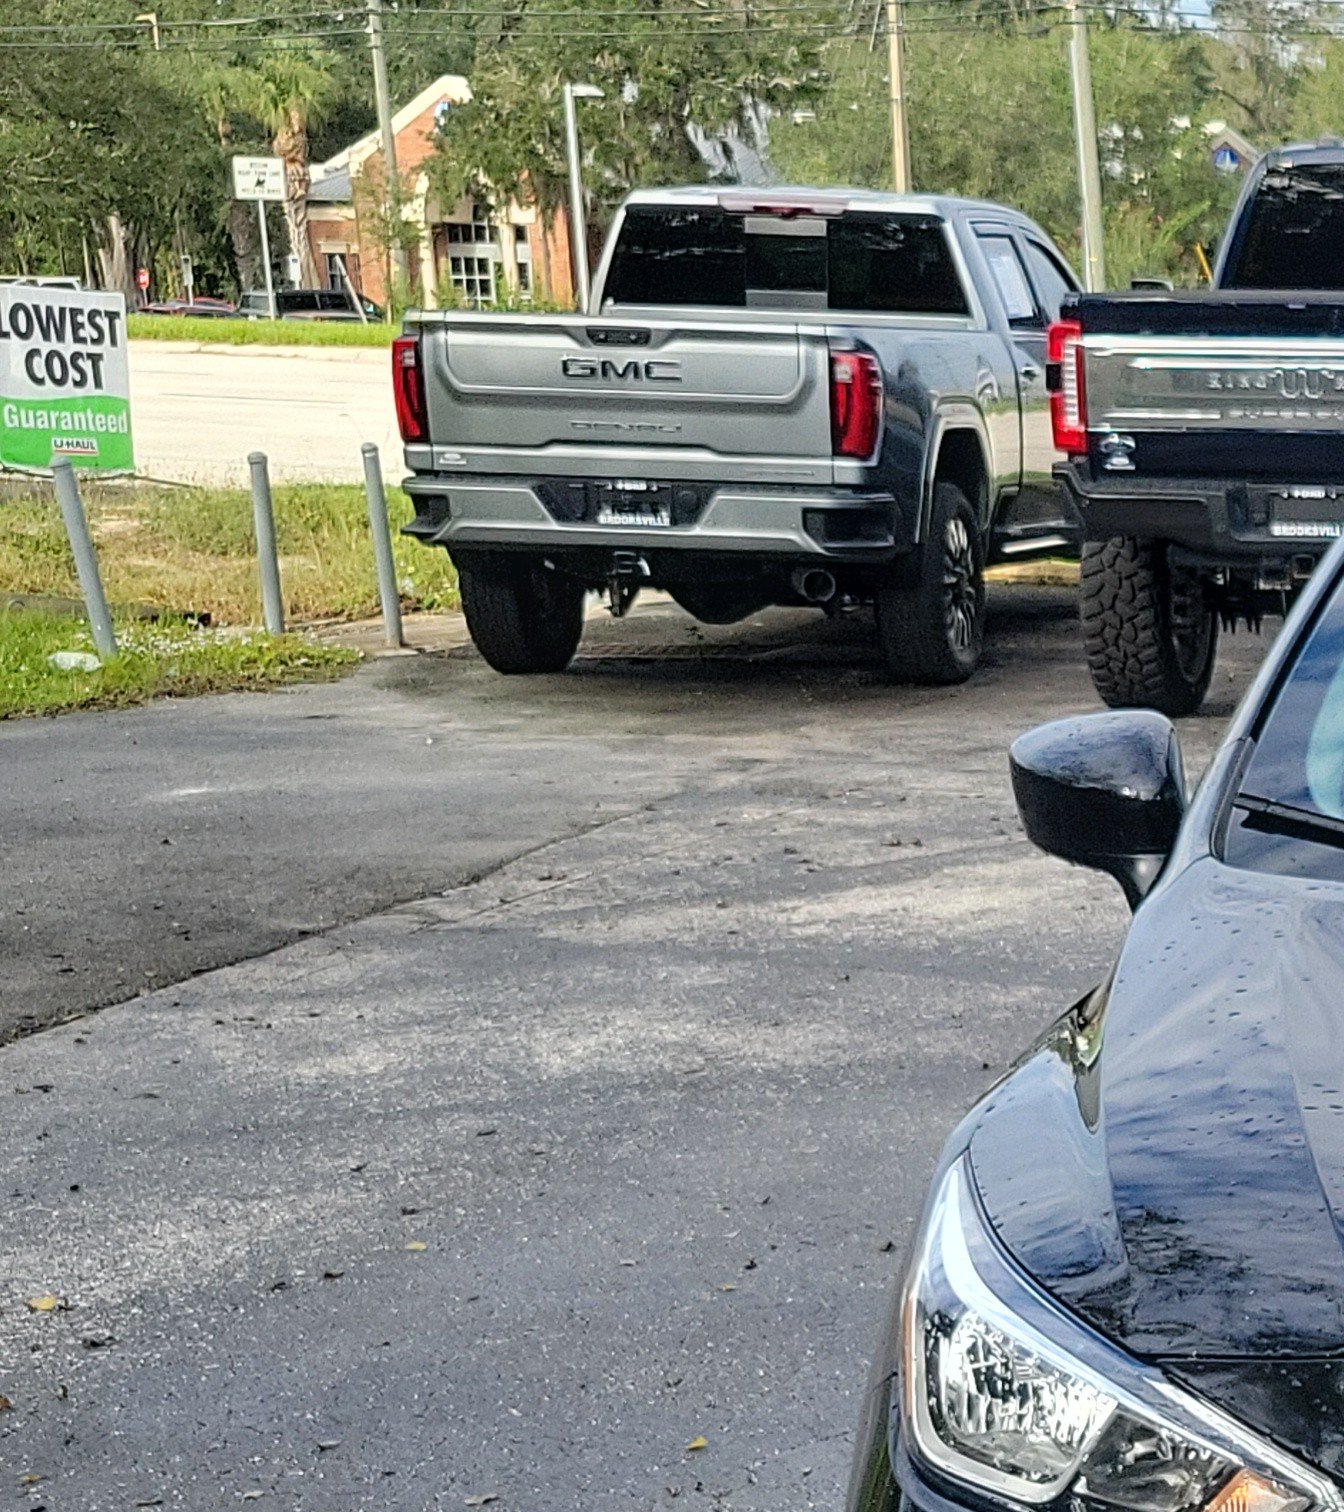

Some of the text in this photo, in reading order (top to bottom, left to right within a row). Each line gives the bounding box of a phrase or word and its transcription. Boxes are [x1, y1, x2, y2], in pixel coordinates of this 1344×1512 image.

[0, 302, 121, 348] LOWEST
[25, 348, 104, 390] COST
[561, 357, 682, 382] GMC
[3, 403, 129, 433] Guaranteed
[1271, 523, 1341, 537] BROOKSVILL
